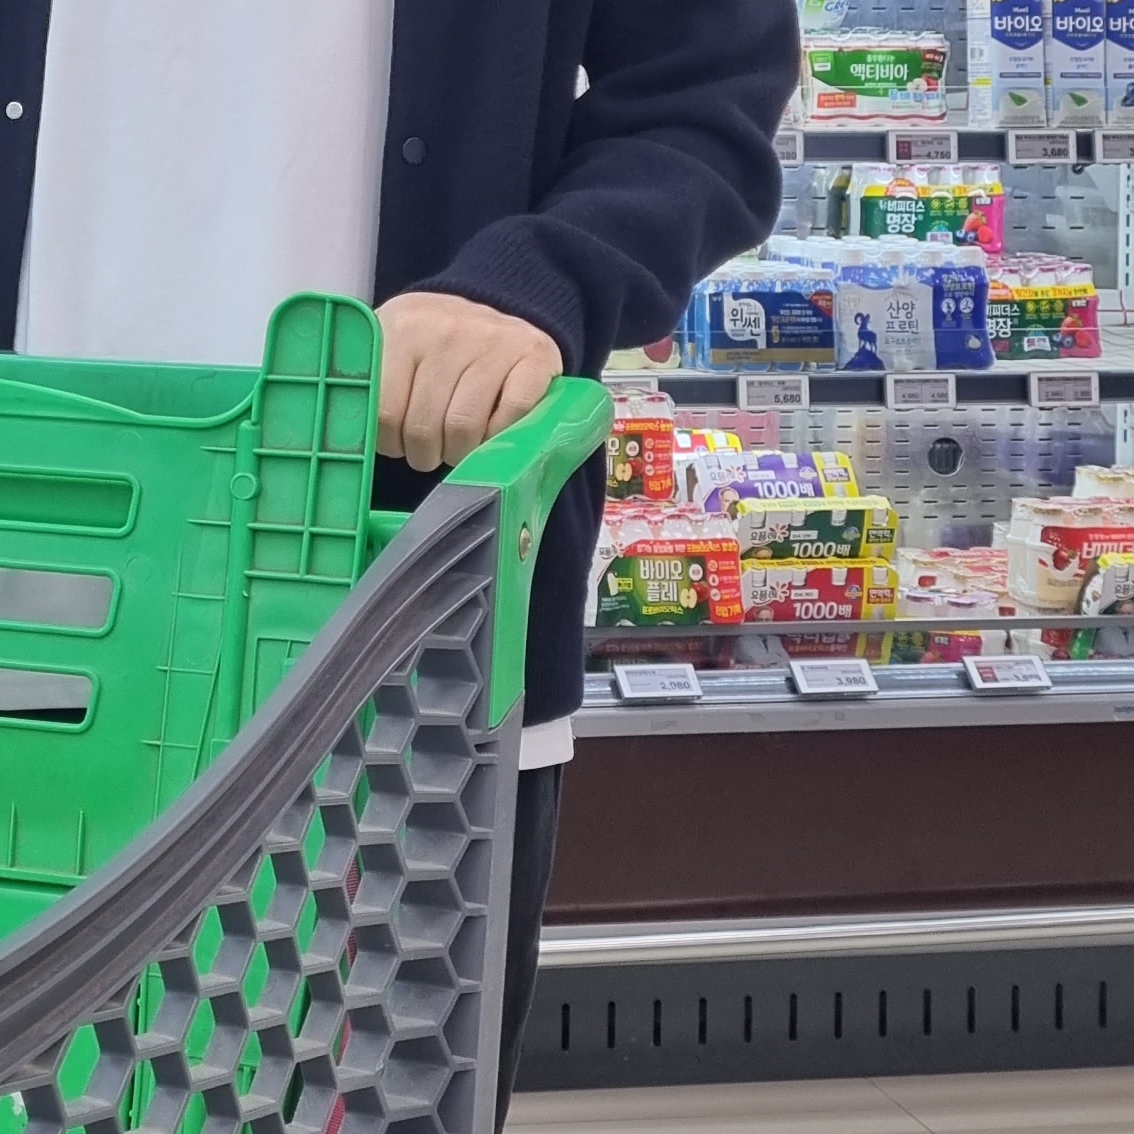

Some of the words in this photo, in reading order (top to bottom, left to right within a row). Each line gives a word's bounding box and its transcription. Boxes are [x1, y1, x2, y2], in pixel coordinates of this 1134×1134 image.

[994, 15, 1043, 33] 바이오
[1056, 15, 1104, 33] 바이오
[850, 63, 909, 81] 액티비아
[887, 200, 925, 213] 비피더스
[885, 214, 918, 234] 명장
[887, 301, 915, 320] 산양
[885, 320, 919, 335] 프로틴
[774, 395, 801, 404] 5,680
[754, 481, 815, 498] 1000배
[750, 531, 777, 541] 요플레
[792, 542, 851, 558] 1000배
[640, 559, 683, 580] 바이오
[646, 581, 678, 603] 플레
[751, 590, 778, 600] 요플레
[793, 602, 853, 619] 1000배
